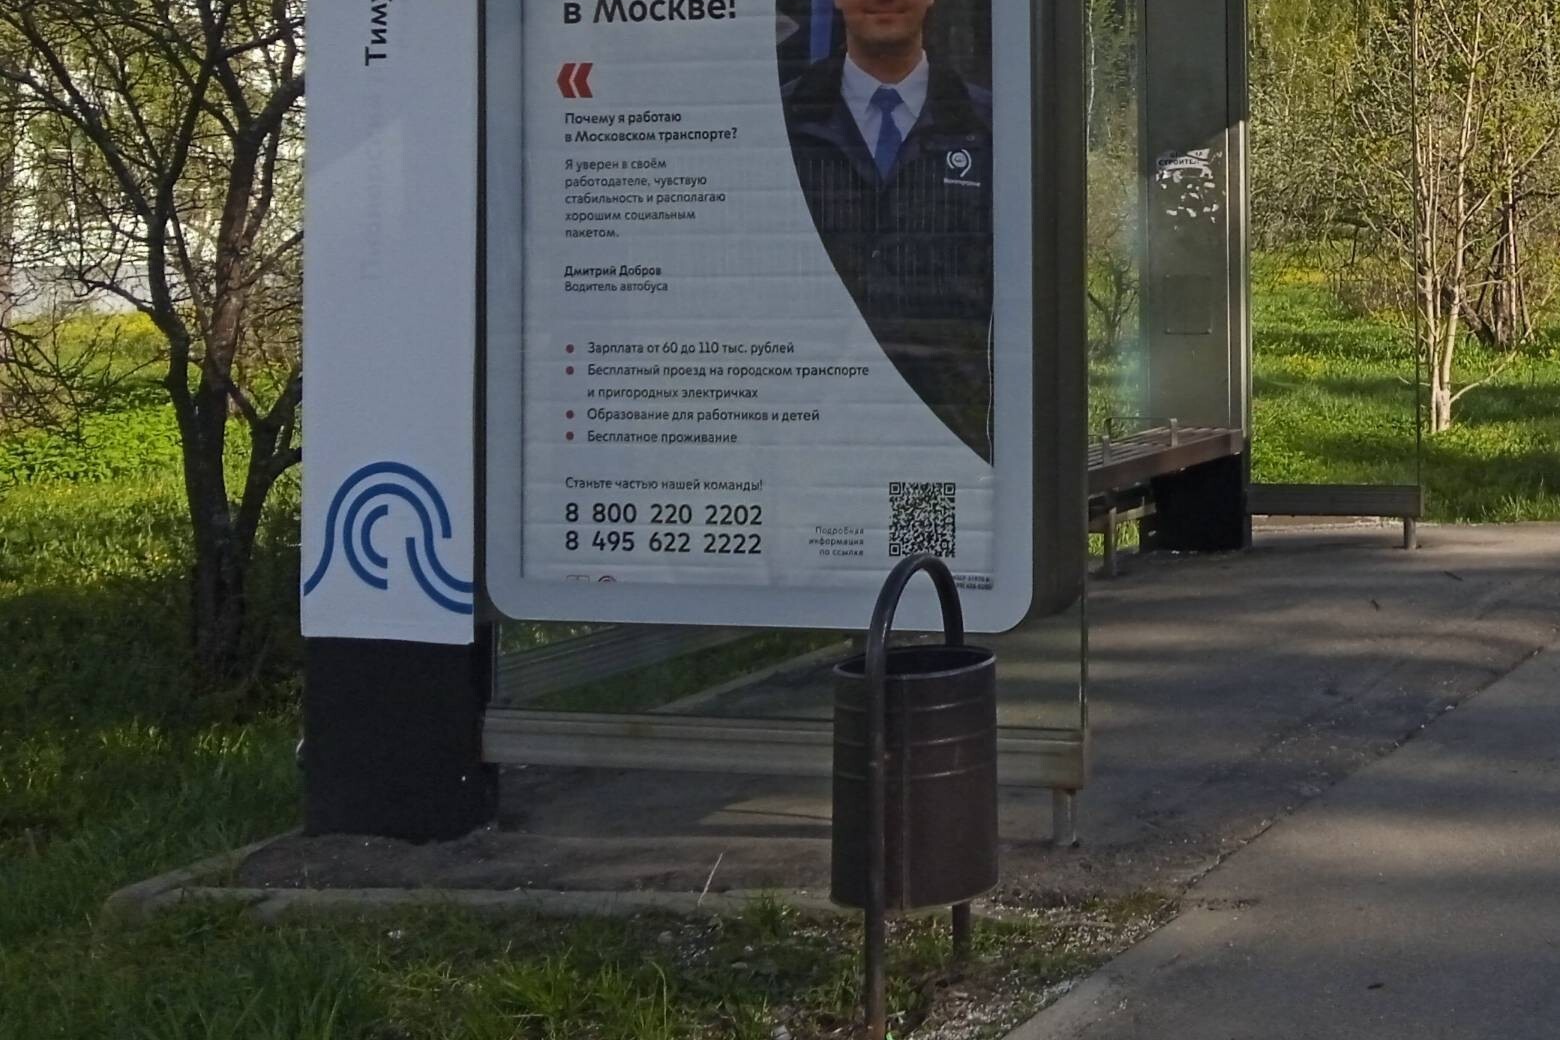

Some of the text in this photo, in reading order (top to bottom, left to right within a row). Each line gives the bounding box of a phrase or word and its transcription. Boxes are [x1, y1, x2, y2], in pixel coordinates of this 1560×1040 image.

[563, 3, 582, 24] в
[565, 110, 682, 127] Почему я работаю
[564, 127, 738, 143] в Московском транспорте?
[565, 158, 667, 173] Я уверен в своём
[564, 175, 708, 190] работодателе, чувствую
[564, 192, 727, 205] стабильность и располагаю
[565, 210, 697, 223] хорошим социальным
[565, 227, 620, 239] пакетом.
[564, 265, 662, 278] Дмитрий Добров
[564, 280, 669, 294] Водитель автобуса
[587, 341, 795, 356] Зарплата от 60 до 110 тыс. рублей
[587, 363, 870, 379] Бесплатный проезд на городском транспорте
[587, 388, 759, 401] и пригородных электричках
[587, 408, 821, 424] Образование для работников и детей
[587, 429, 738, 445] Бесплатное проживание
[565, 476, 763, 492] Станьте частью нашей команды!
[565, 502, 763, 526] 8 800 220 2202
[565, 530, 762, 555] 8 495 622 2222
